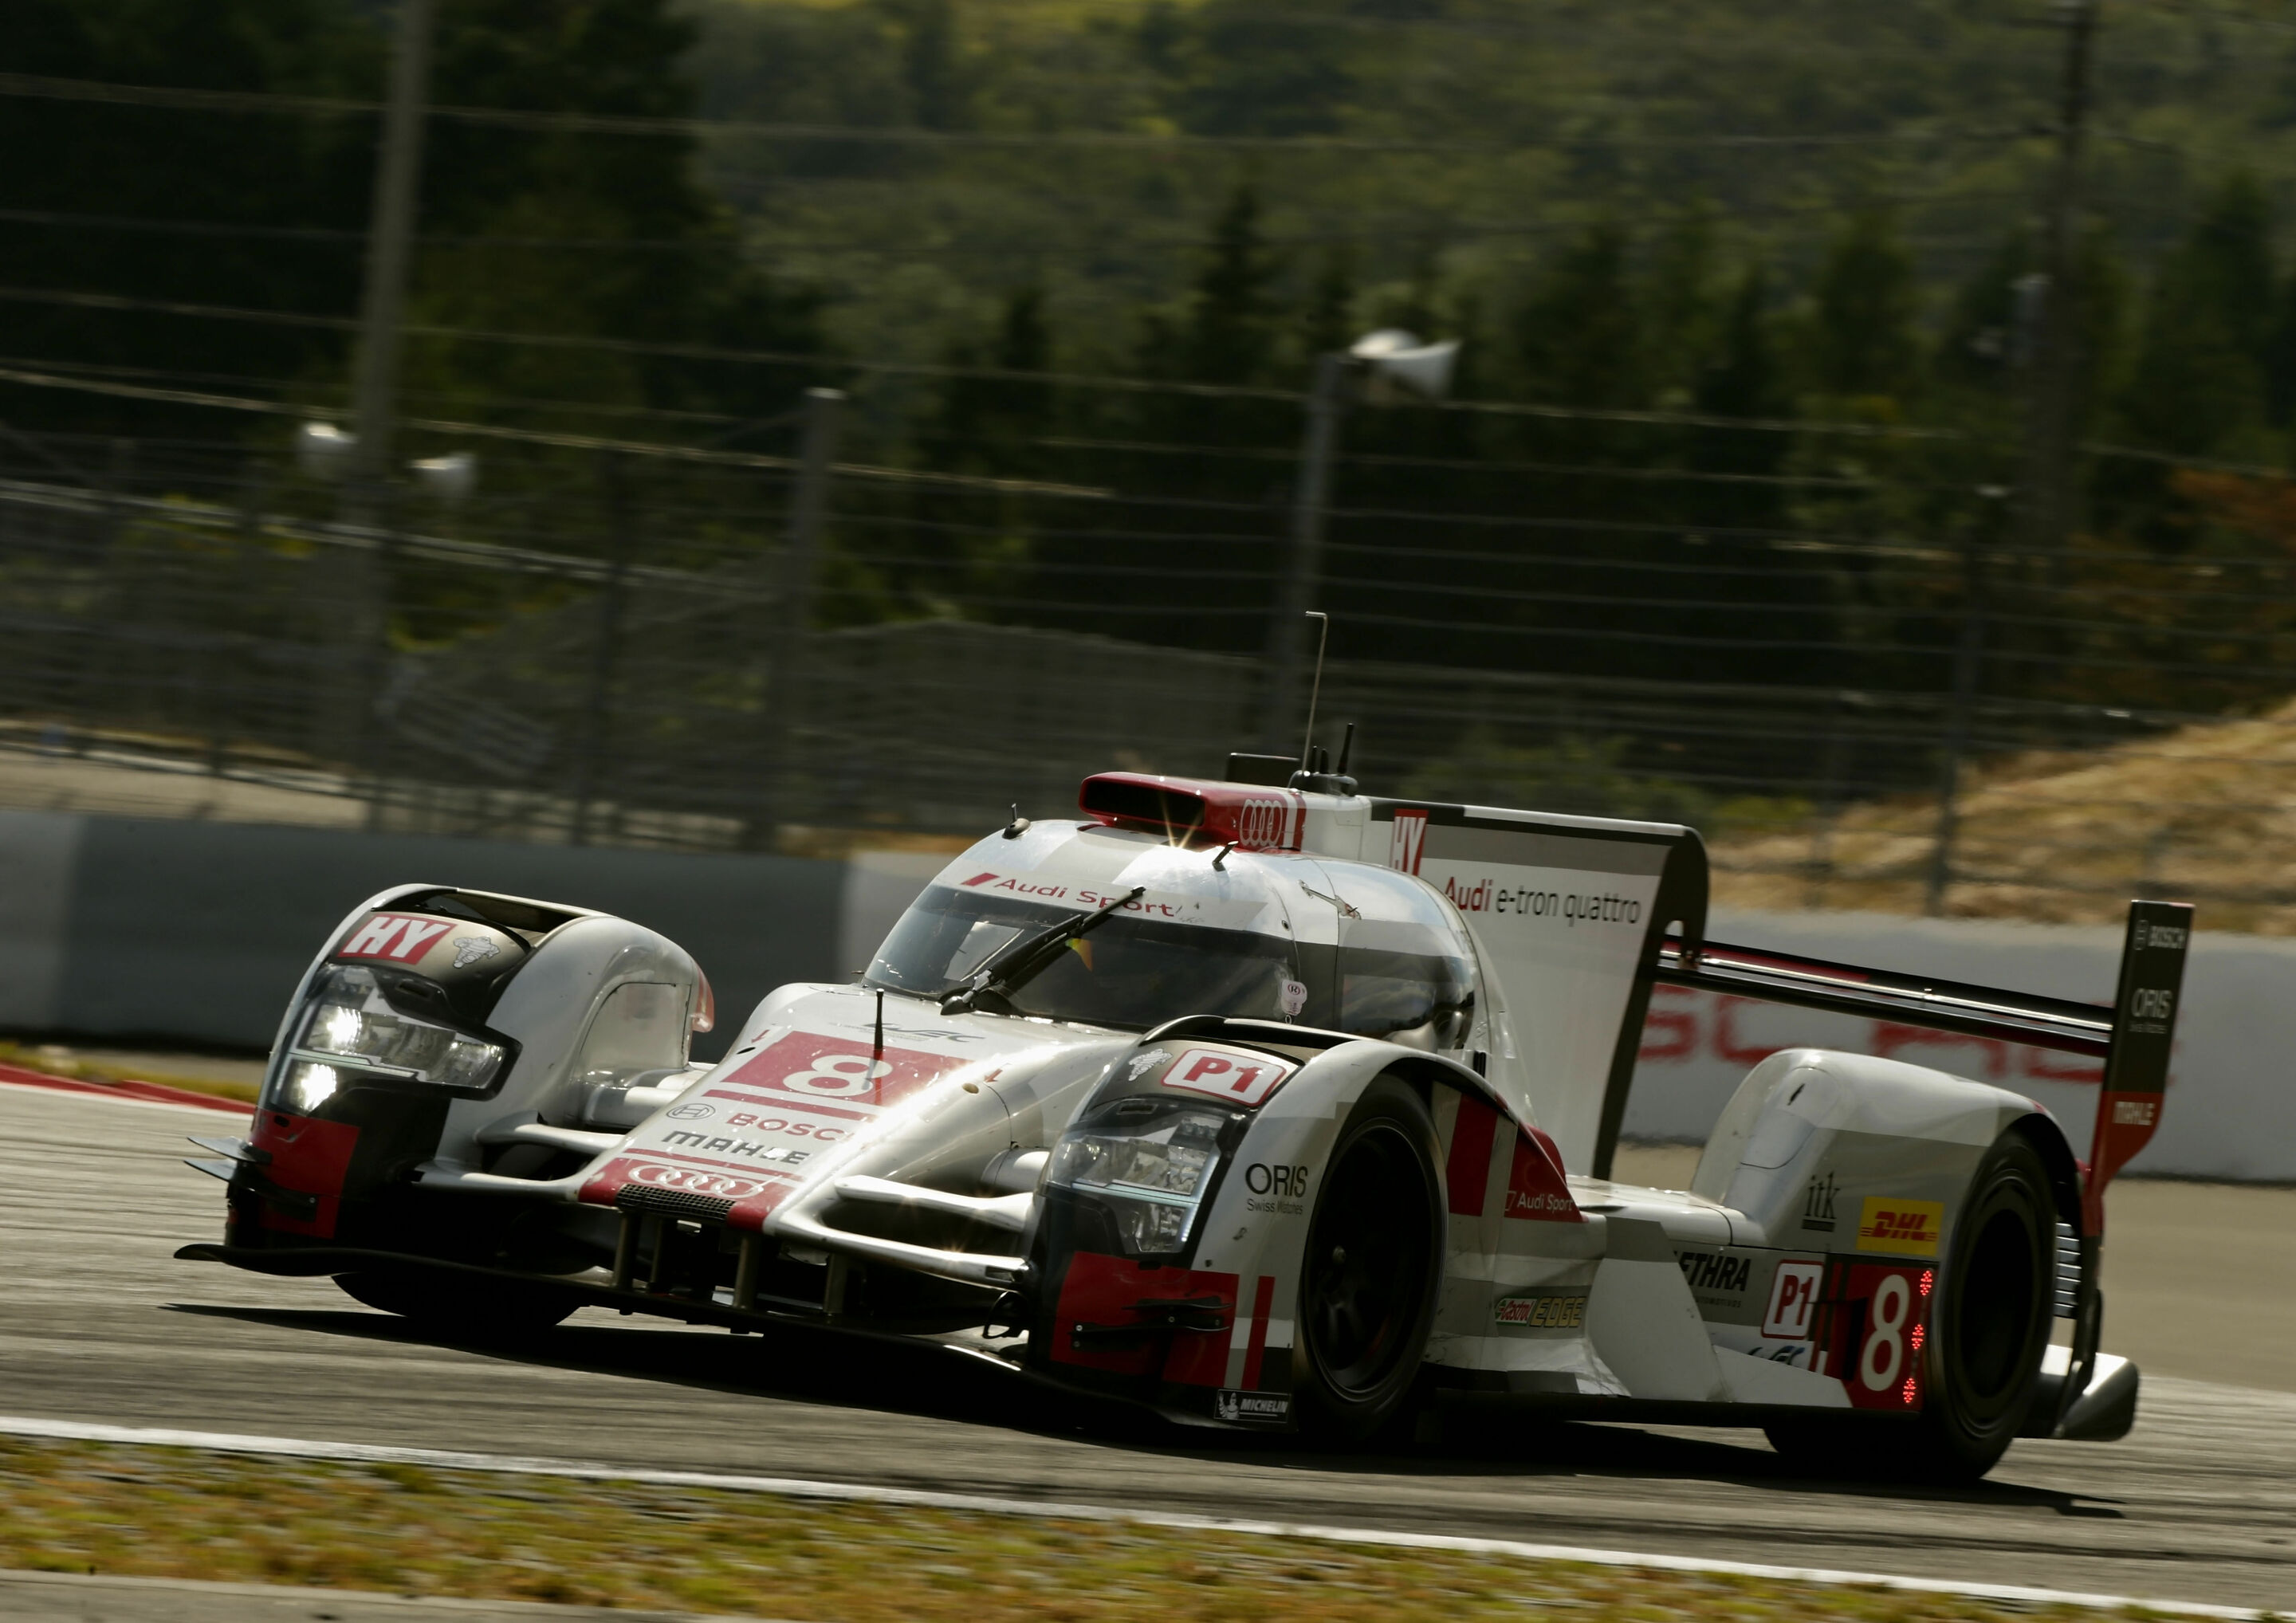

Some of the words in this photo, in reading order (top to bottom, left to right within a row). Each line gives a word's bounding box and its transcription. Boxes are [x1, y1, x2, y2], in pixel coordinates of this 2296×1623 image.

[1391, 815, 1426, 875] HY
[994, 878, 1068, 898] Audi
[1076, 890, 1175, 918] Sport
[1445, 876, 1493, 912] Audi
[1496, 885, 1560, 918] e-tron
[1563, 891, 1641, 928] quattro
[342, 916, 451, 959] HY
[2131, 988, 2173, 1019] ORIS
[782, 1054, 894, 1098] 8
[1183, 1055, 1264, 1094] P1
[724, 1112, 855, 1142] BOSC
[1245, 1162, 1308, 1198] ORIS
[1804, 1170, 1841, 1220] itk
[1246, 1197, 1276, 1212] Swiss
[1517, 1192, 1544, 1209] Audi
[1545, 1194, 1575, 1214] Sport
[1872, 1210, 1928, 1242] DHL
[1529, 1296, 1588, 1328] EDGE
[1773, 1274, 1814, 1326] P1
[1860, 1274, 1910, 1392] 8
[1240, 1397, 1289, 1413] MICHELIN
